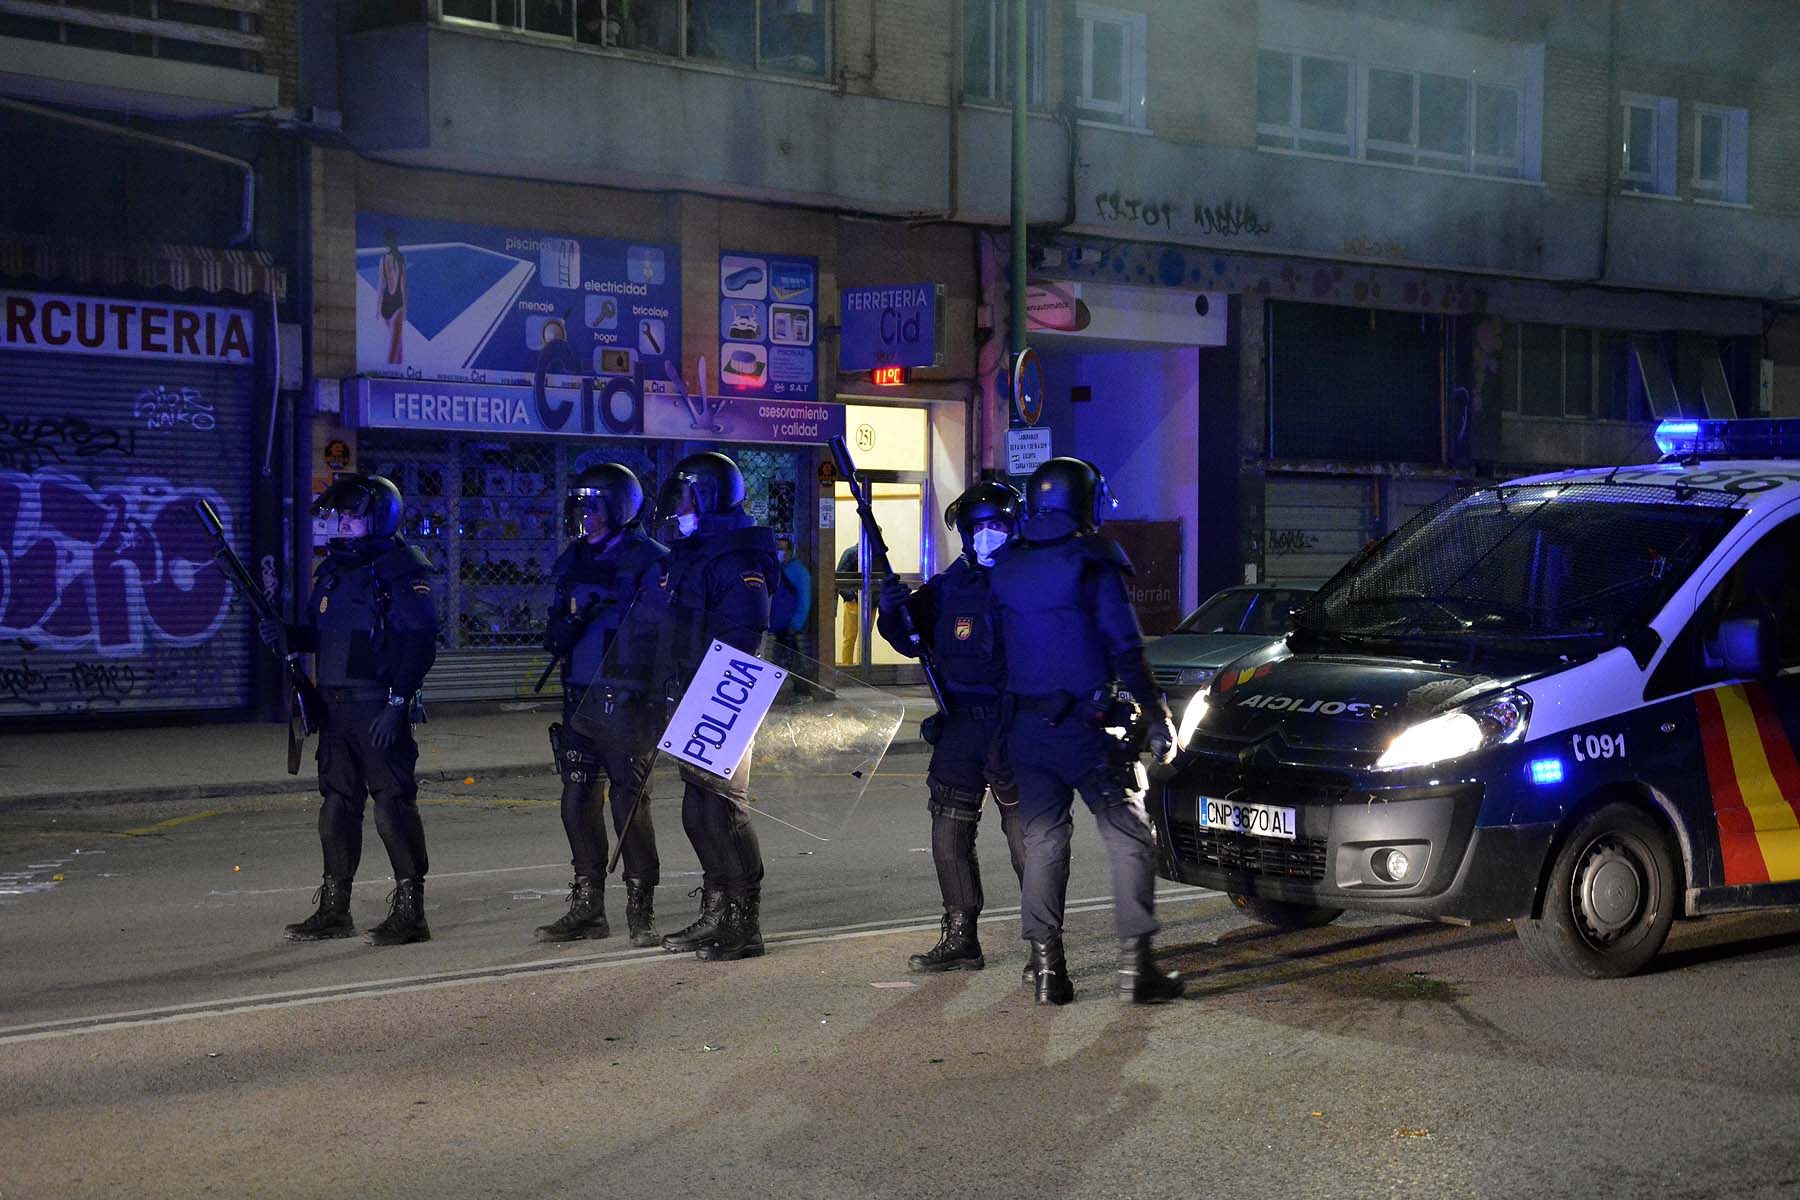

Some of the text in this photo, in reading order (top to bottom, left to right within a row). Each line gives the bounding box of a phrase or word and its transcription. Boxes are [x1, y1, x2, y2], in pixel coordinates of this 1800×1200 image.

[584, 279, 648, 296] electricidad
[518, 300, 555, 313] menaje
[847, 288, 928, 311] FERRETERIA
[632, 304, 669, 319] bricolaje
[0, 296, 250, 358] RCUTERIA
[880, 306, 920, 345] Cid
[594, 331, 618, 344] hogar
[393, 340, 644, 434] FERRETERIA Cid
[759, 405, 829, 421] asesoramiento
[772, 422, 819, 437] y calidad
[858, 428, 873, 447] 251
[683, 659, 763, 765] POLICIA
